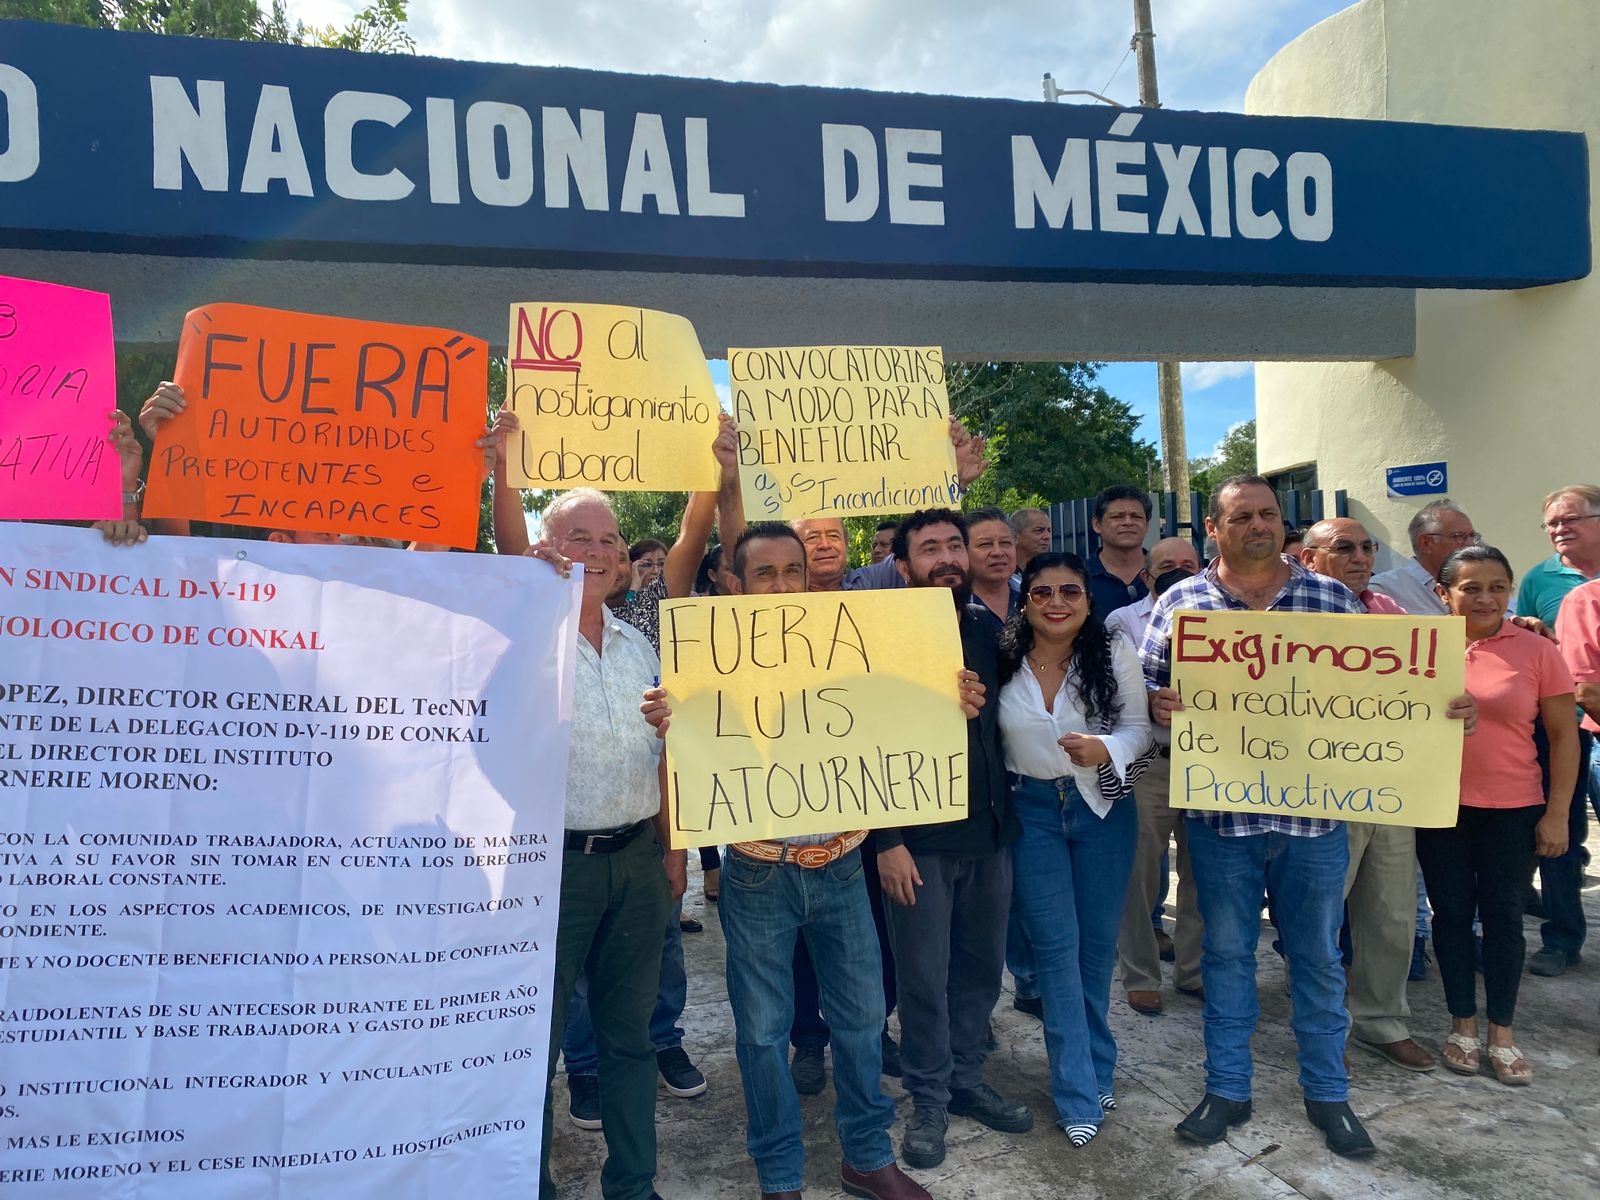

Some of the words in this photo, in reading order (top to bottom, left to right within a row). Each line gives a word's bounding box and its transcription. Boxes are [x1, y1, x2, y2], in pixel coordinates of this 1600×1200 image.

[149, 75, 746, 218] NACIONAL
[822, 123, 945, 226] DE
[1011, 113, 1333, 242] MÉXICO
[516, 306, 583, 363] NO
[607, 310, 648, 361] al
[0, 364, 88, 401] RIA
[731, 347, 945, 385] CONVOCATORIAS
[511, 367, 709, 431] hostigamiento
[735, 389, 756, 424] A
[765, 386, 854, 423] MODO
[870, 385, 943, 419] PARA
[209, 408, 435, 453] AUTORIDADES
[738, 423, 910, 466] BENEFICIAR
[0, 433, 104, 486] ATIVA
[160, 445, 382, 487] PREPOTENTES
[755, 474, 775, 491] a
[220, 494, 441, 530] INCAPACES
[25, 569, 169, 597] SINDICAL
[179, 579, 277, 602] D-V-119
[0, 615, 153, 643] OLOGICO
[163, 625, 199, 645] DE
[208, 626, 325, 650] CONKAL
[665, 601, 871, 675] FUERA
[1177, 615, 1438, 680] Exigimos!!
[77, 686, 218, 709] DIRECTOR
[227, 691, 348, 714] GENERAL
[355, 697, 405, 715] DEL
[412, 698, 489, 717] TecNM
[716, 688, 854, 739] LUIS
[1232, 676, 1431, 721] reativación
[51, 716, 82, 732] DE
[90, 717, 120, 734] LA
[128, 718, 278, 737] DELEGACION
[285, 723, 360, 740] D-V-119
[367, 726, 394, 741] DE
[400, 727, 490, 743] CONKAL
[1177, 721, 1219, 754] de
[1241, 726, 1289, 761] las
[1308, 738, 1404, 763] areas
[31, 744, 157, 763] DIRECTOR
[164, 748, 207, 764] DEL
[214, 748, 333, 767] INSTITUTO
[99, 771, 218, 790] MORENO:
[673, 746, 965, 832] LATOURNERIE
[1185, 764, 1403, 813] Productivas
[0, 853, 37, 866] IVA
[50, 854, 64, 866] A
[75, 853, 99, 866] SU
[111, 853, 176, 866] FAVOR
[191, 854, 221, 866] SIN
[232, 854, 297, 867] TOMAR
[307, 855, 330, 867] EN
[341, 855, 411, 868] CUENTA
[422, 856, 454, 868] LOS
[464, 851, 547, 867] DERECHOS
[44, 833, 69, 846] LA
[80, 833, 197, 846] COMUNIDAD
[206, 834, 342, 850] TRABAJADORA,
[350, 837, 446, 849] ACTUANDO
[454, 837, 476, 849] DE
[483, 833, 548, 848] MANERA
[9, 873, 103, 886] LABORAL
[109, 873, 226, 886] CONSTANTE.
[0, 904, 17, 917] O
[30, 904, 56, 917] EN
[69, 904, 107, 917] LOS
[120, 903, 215, 916] ASPECTOS
[226, 903, 350, 917] ACADEMICOS,
[361, 904, 384, 916] DE
[396, 897, 524, 916] INVESTIGACION
[532, 896, 544, 907] Y
[25, 955, 39, 969] Y
[43, 955, 71, 968] NO
[76, 953, 169, 968] DOCENTE
[173, 952, 309, 966] BENEFICIANDO
[313, 953, 324, 965] A
[328, 951, 420, 965] PERSONAL
[425, 950, 446, 963] DE
[450, 941, 539, 961] CONFIANZA
[150, 1004, 172, 1017] DE
[178, 1004, 202, 1017] SU
[207, 1003, 316, 1017] ANTECESOR
[323, 1000, 407, 1015] DURANTE
[413, 1000, 434, 1011] EL
[440, 991, 500, 1009] PRIMER
[505, 985, 538, 999] AÑO
[135, 1025, 148, 1038] Y
[153, 1025, 199, 1038] BASE
[207, 1022, 340, 1037] TRABAJADORA
[348, 1021, 360, 1033] Y
[365, 1018, 423, 1032] GASTO
[430, 1015, 450, 1028] DE
[455, 1003, 536, 1025] RECURSOS
[18, 1077, 174, 1097] INSTITUCIONAL
[185, 1073, 307, 1089] INTEGRADOR
[319, 1072, 331, 1084] Y
[342, 1061, 453, 1083] VINCULANTE
[461, 1054, 496, 1070] CON
[503, 1048, 532, 1062] LOS
[0, 1105, 19, 1118] S.
[7, 1135, 50, 1150] MAS
[56, 1134, 81, 1148] LE
[87, 1129, 185, 1146] EXIGIMOS
[52, 1162, 142, 1182] MORENO
[148, 1162, 162, 1174] Y
[168, 1159, 192, 1173] EL
[198, 1156, 245, 1171] CESE
[252, 1149, 357, 1168] INMEDIATO
[362, 1146, 386, 1160] AL
[392, 1119, 525, 1156] HOSTIGAMIENTO
